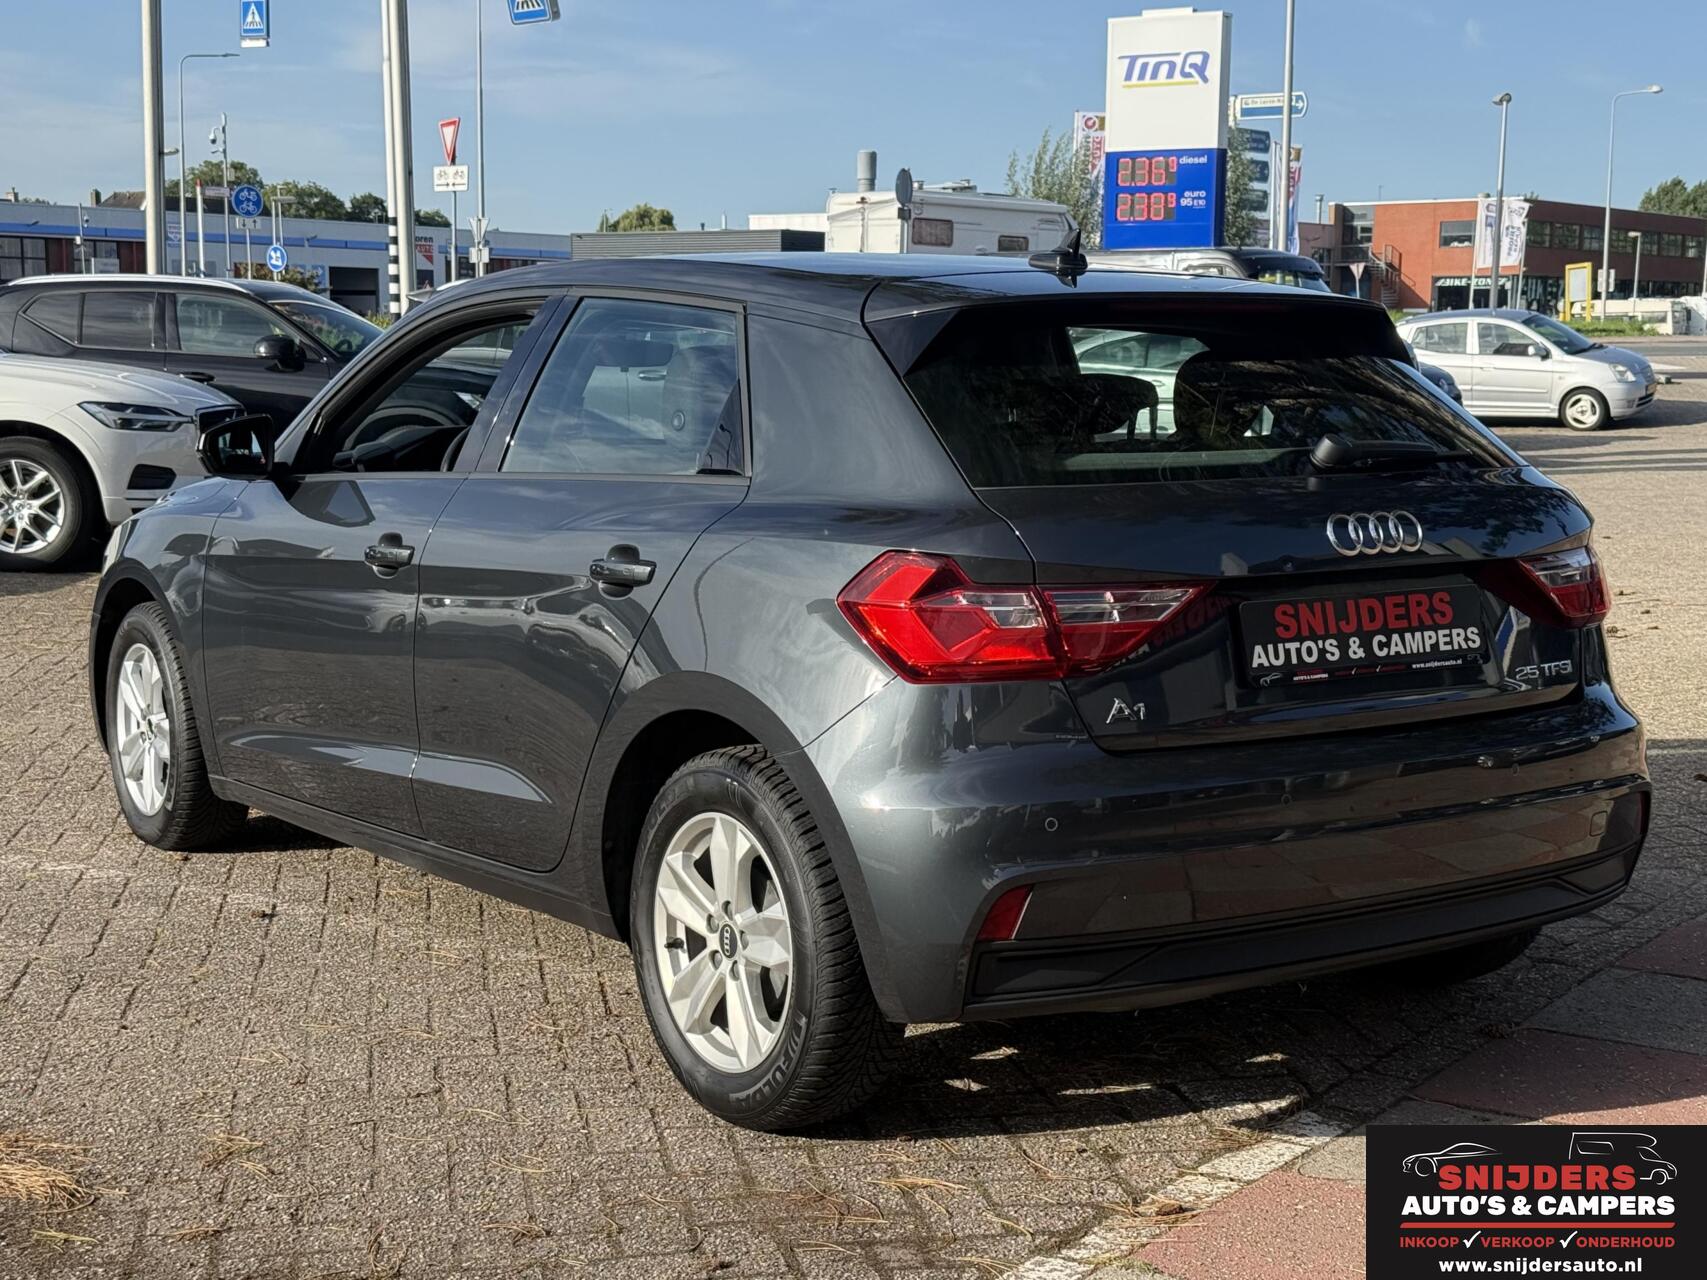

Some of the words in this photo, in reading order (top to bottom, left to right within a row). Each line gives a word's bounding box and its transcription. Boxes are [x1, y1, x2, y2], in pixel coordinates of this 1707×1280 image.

[1179, 155, 1208, 164] diesel
[1184, 190, 1206, 198] euro
[1180, 198, 1193, 207] 95
[1274, 591, 1454, 639] SNIJDERS
[1252, 639, 1340, 668] AUTO'S
[1349, 637, 1366, 659] &
[1372, 626, 1481, 657] CAMPERS
[1515, 665, 1539, 680] 25
[1105, 697, 1145, 724] A1
